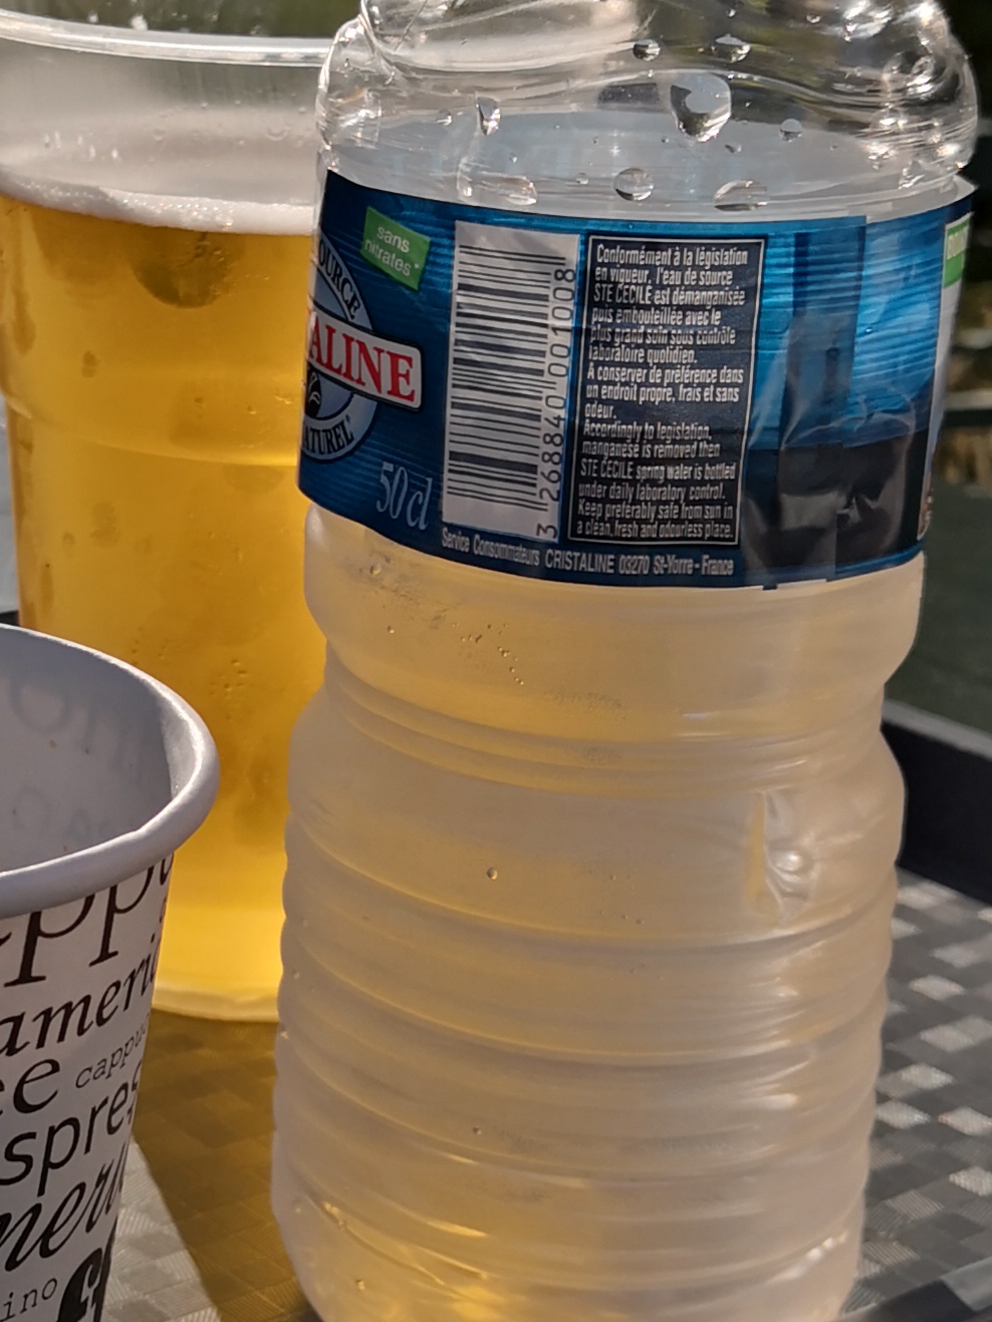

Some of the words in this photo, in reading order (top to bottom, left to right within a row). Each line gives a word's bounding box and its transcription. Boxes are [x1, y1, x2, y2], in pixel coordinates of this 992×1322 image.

[377, 226, 410, 254] sans
[683, 247, 691, 265] la
[595, 267, 607, 280] en
[684, 267, 696, 285] de
[699, 271, 733, 285] source
[594, 284, 612, 302] STE
[654, 289, 670, 305] est
[685, 311, 708, 325] avec
[711, 308, 721, 325] le
[615, 326, 644, 346] grand
[670, 329, 694, 345] sous
[597, 367, 647, 382] conserver
[649, 365, 662, 383] de
[720, 366, 743, 383] dans
[586, 385, 598, 398] un
[601, 383, 637, 401] endroit
[678, 384, 701, 401] frais
[704, 385, 714, 401] et
[716, 388, 739, 402] sans
[645, 422, 654, 439] to
[642, 441, 650, 457] is
[654, 442, 697, 458] removed
[699, 441, 720, 457] then
[580, 459, 597, 476] STE
[667, 465, 693, 479] water
[694, 463, 702, 479] is
[579, 480, 607, 498] under
[609, 483, 634, 502] daily
[578, 499, 602, 519] Keep
[605, 501, 656, 522] preferably
[658, 502, 679, 519] safe
[681, 503, 702, 519] from
[704, 506, 721, 519] sun
[724, 503, 733, 519] in
[577, 521, 582, 533] a
[640, 521, 657, 537] and
[441, 526, 470, 553] Service
[545, 548, 615, 574] CRISTALINE
[701, 554, 733, 575] France
